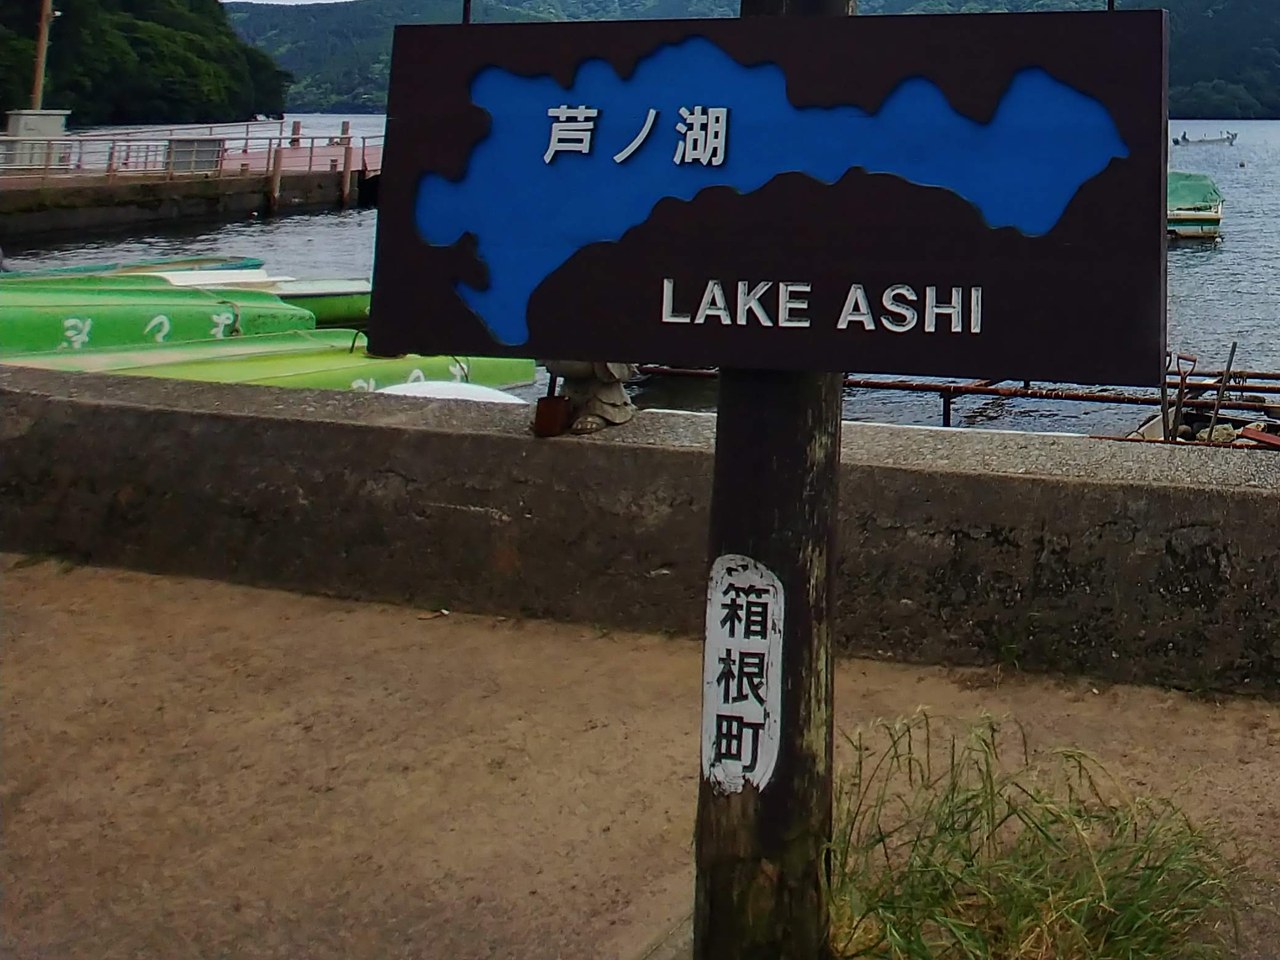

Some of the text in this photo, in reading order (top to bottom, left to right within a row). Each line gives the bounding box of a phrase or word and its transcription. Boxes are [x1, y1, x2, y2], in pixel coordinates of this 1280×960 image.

[543, 104, 728, 166] 芦ノ湖
[662, 278, 982, 333] LAKE ASHI
[714, 582, 771, 774] 箱根町
